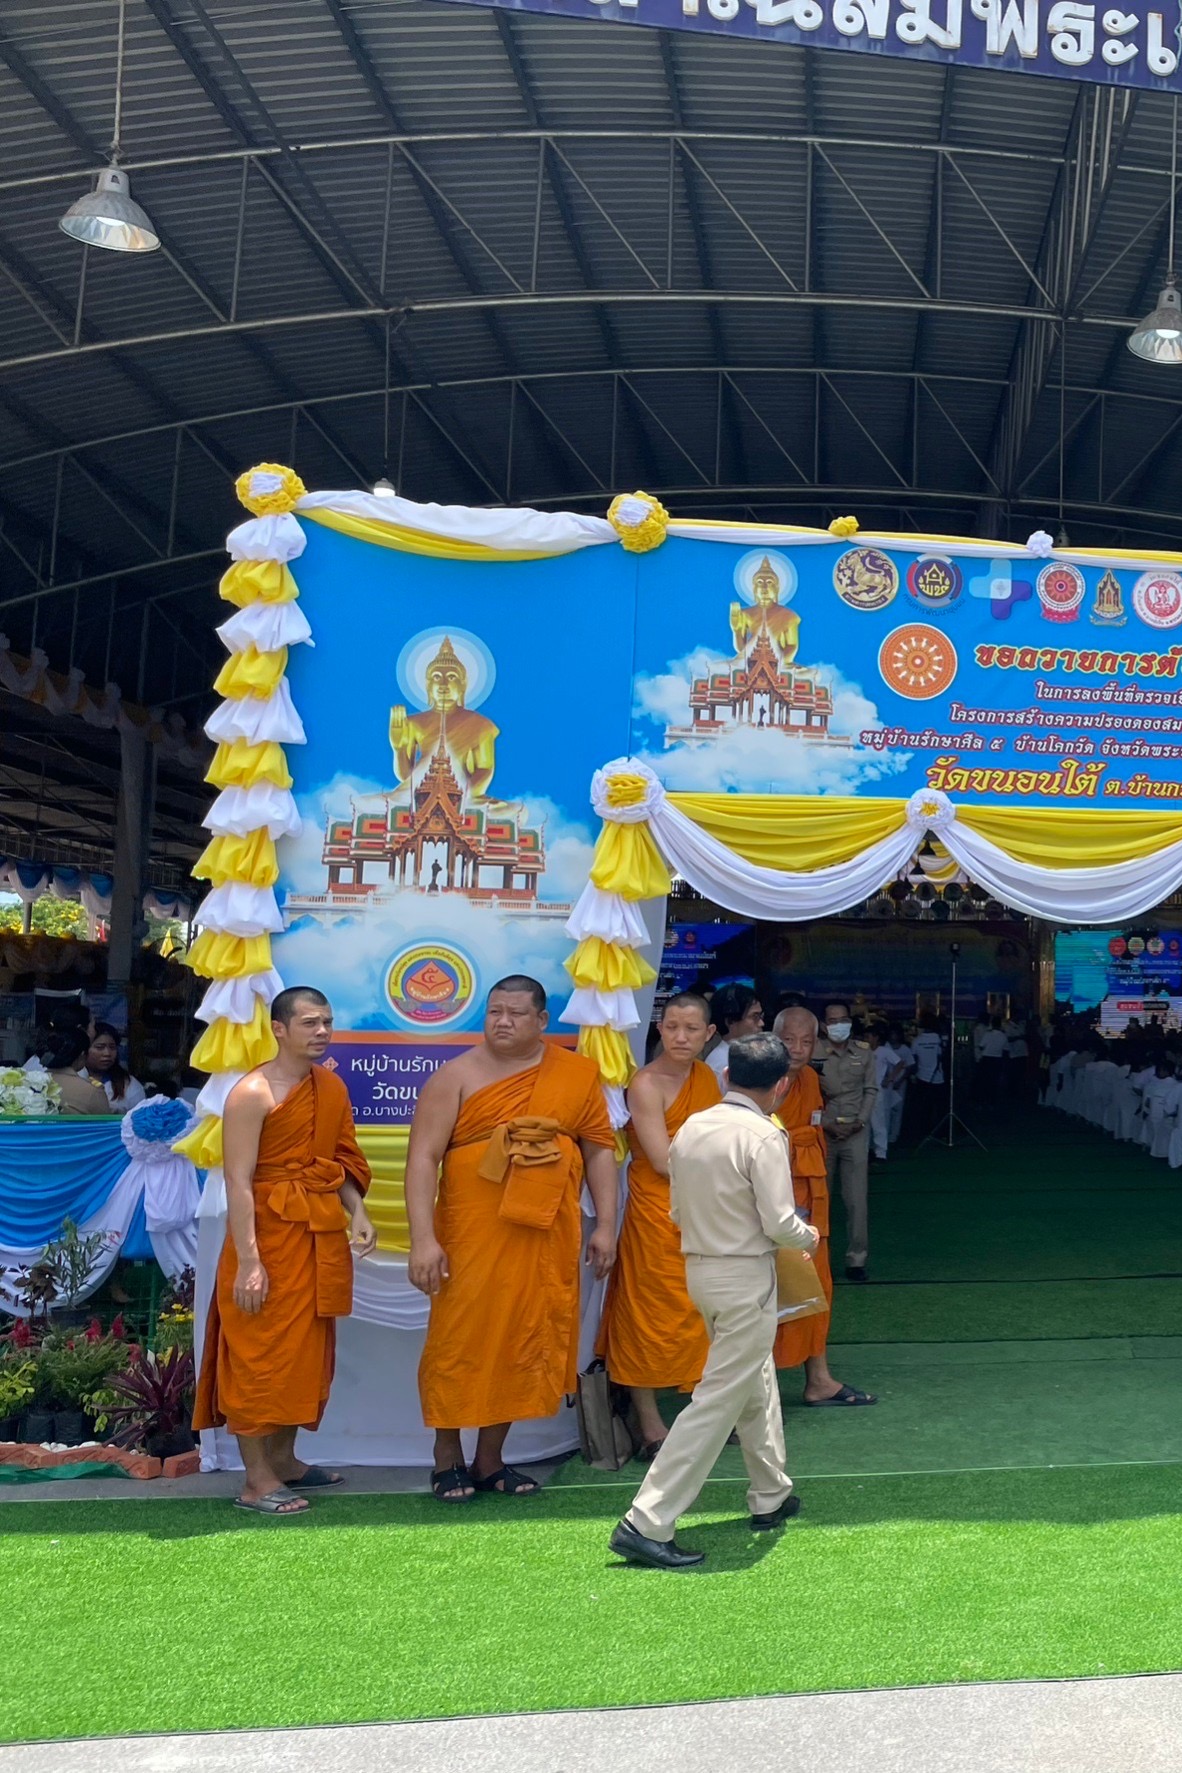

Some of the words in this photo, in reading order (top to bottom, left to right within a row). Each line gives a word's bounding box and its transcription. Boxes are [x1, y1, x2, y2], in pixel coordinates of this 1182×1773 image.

[861, 728, 982, 751] หมู่บ้านรักษาศีล
[990, 738, 1004, 751] ๕
[1015, 735, 1094, 755] บ้านโคกวัด
[926, 757, 1105, 796] วัดขนอนใต้
